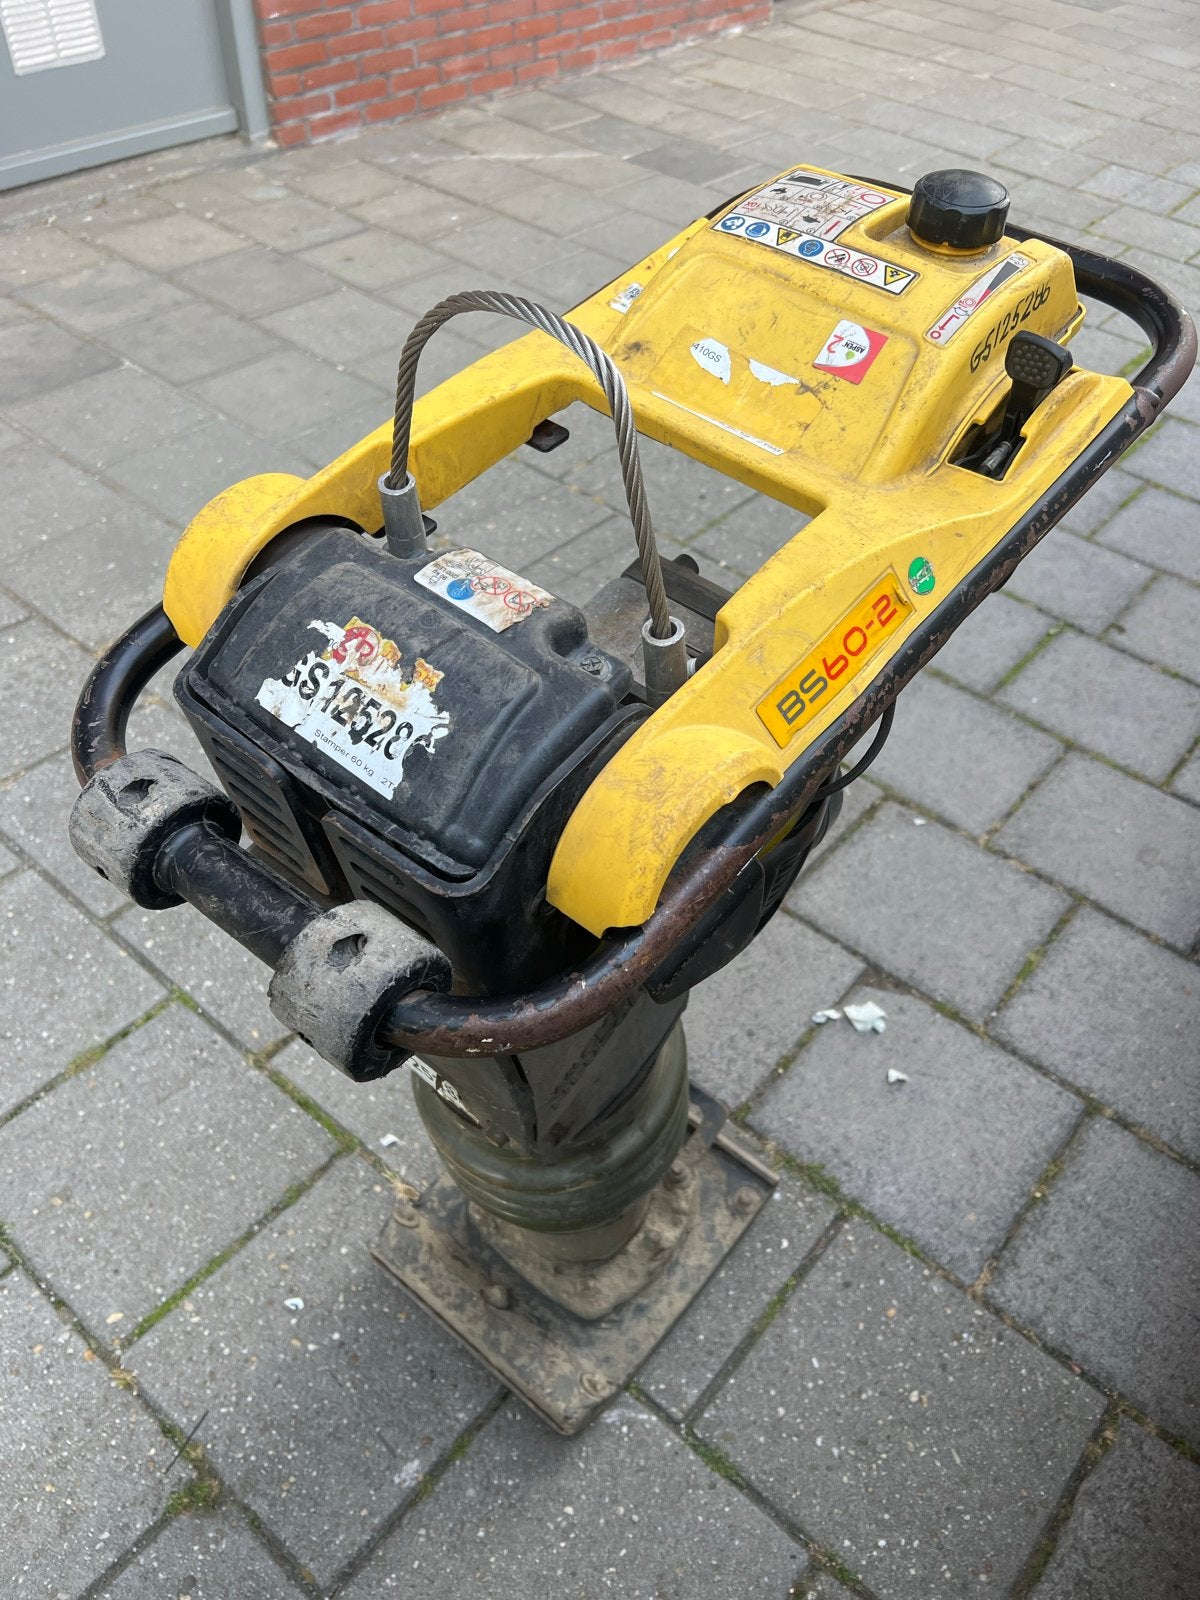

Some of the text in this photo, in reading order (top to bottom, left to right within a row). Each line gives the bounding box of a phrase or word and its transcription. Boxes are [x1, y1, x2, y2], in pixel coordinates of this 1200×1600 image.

[690, 342, 722, 363] 410GS
[827, 334, 845, 354] 2
[843, 340, 867, 354] ASPEN
[776, 594, 898, 725] BS60-2
[314, 728, 355, 758] Stamper
[351, 754, 363, 768] 60
[361, 761, 375, 777] kg
